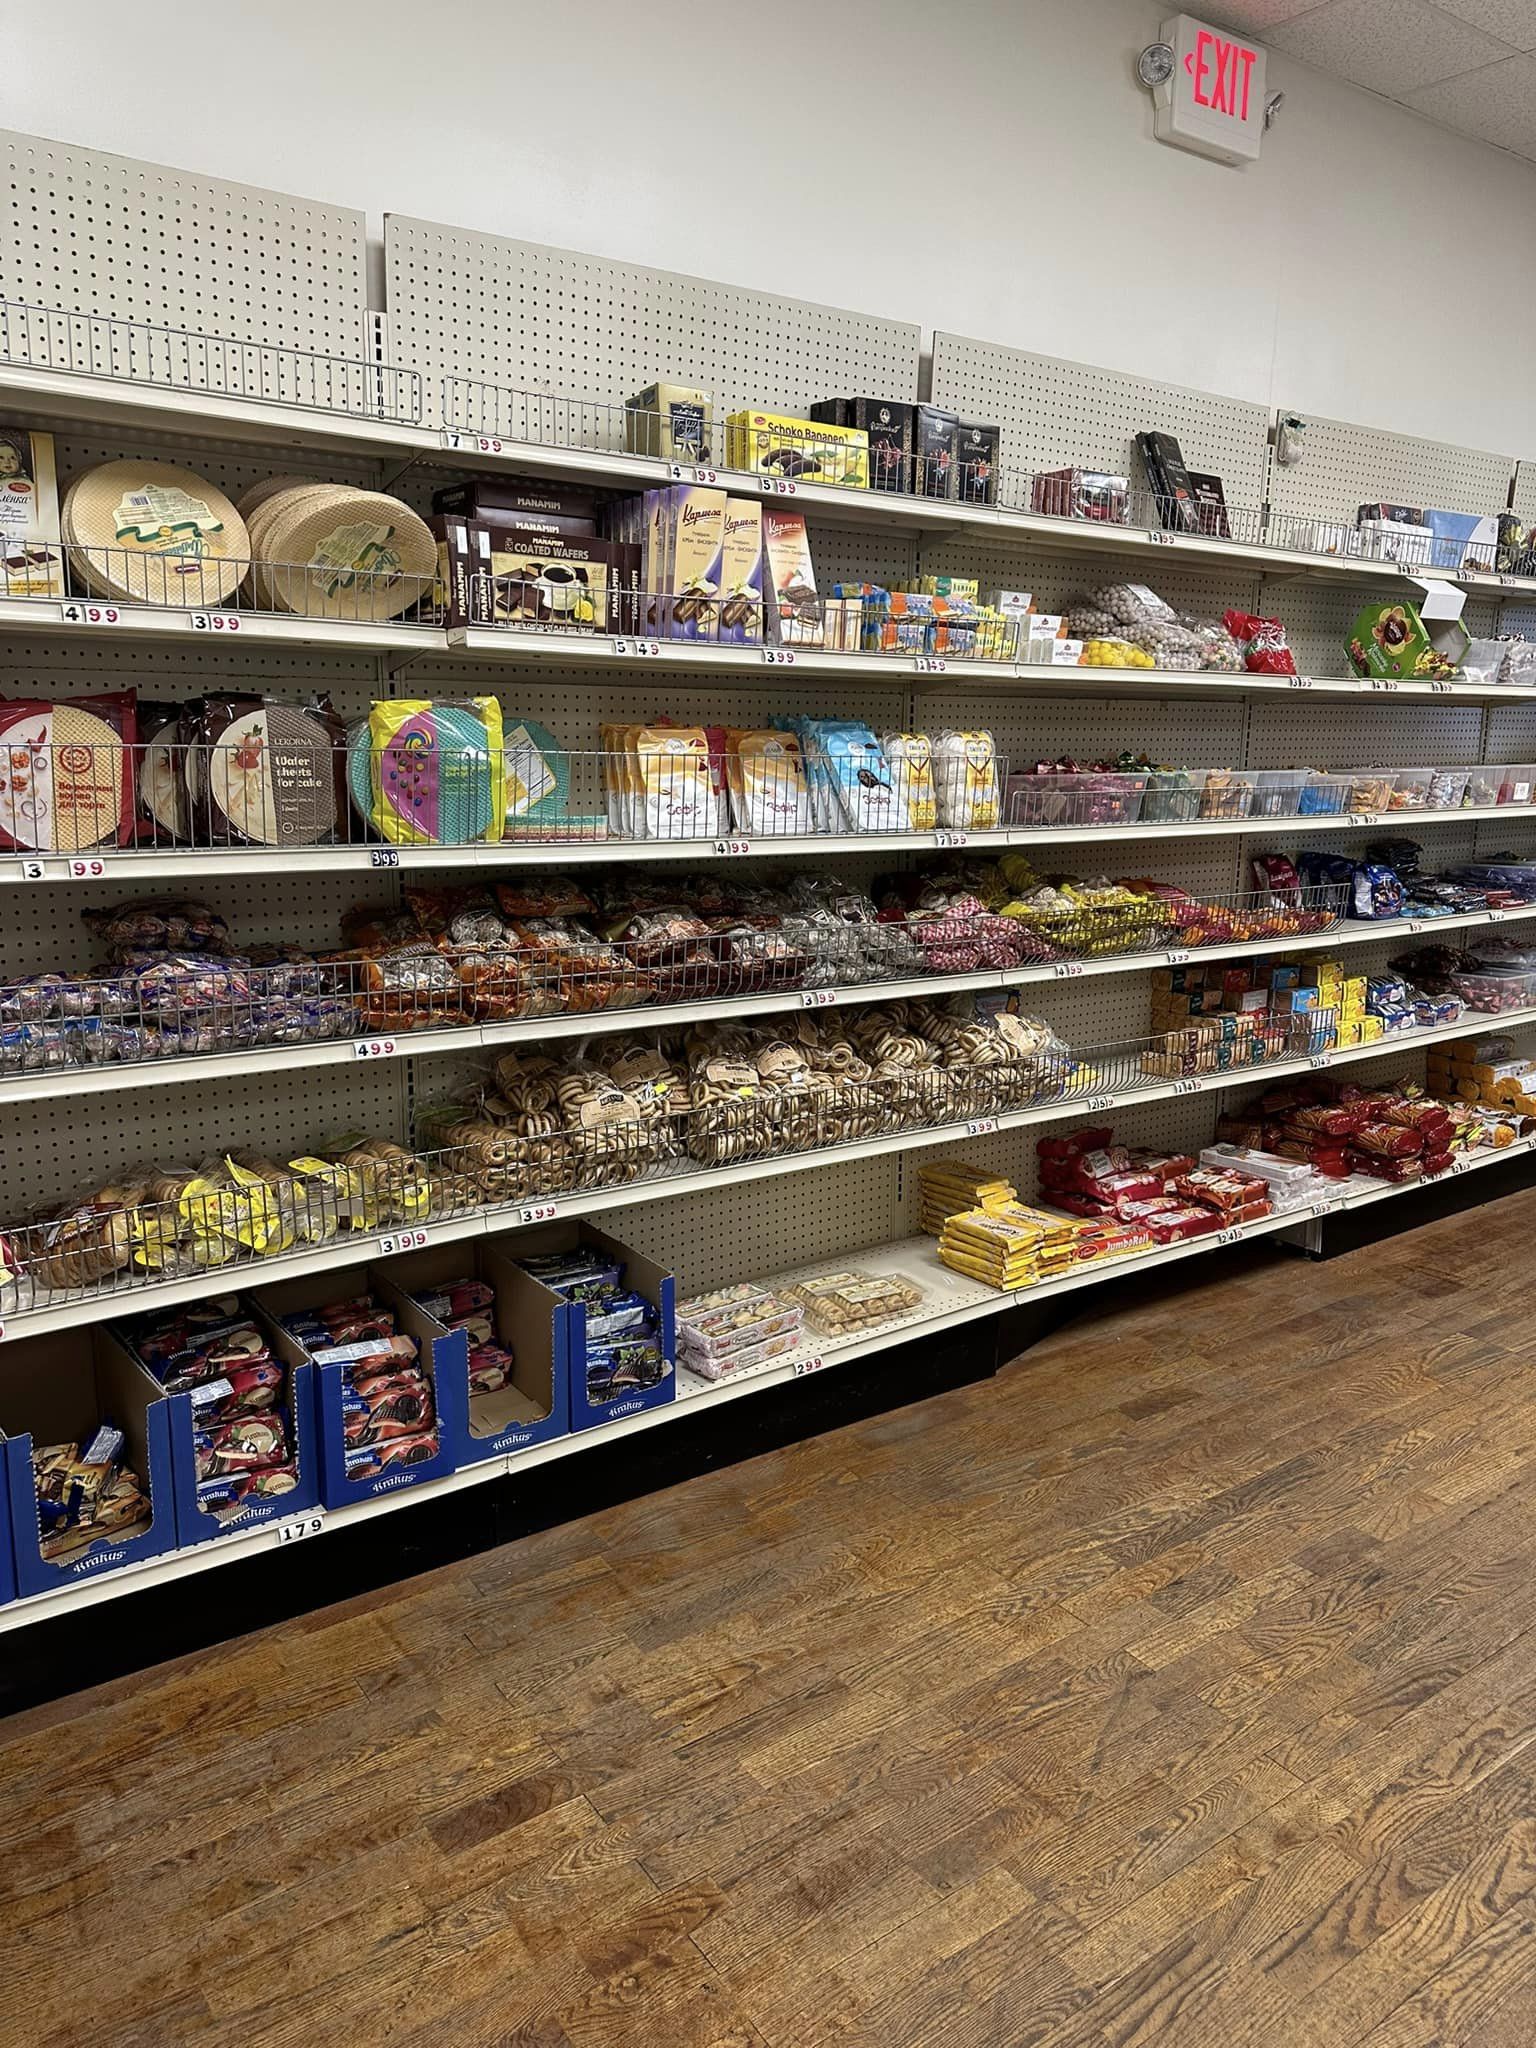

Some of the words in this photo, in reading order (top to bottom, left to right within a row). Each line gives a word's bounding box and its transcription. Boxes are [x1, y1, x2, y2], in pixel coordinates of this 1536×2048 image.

[1193, 29, 1257, 121] EXIT
[767, 421, 802, 439] Schoko
[450, 434, 460, 448] 7
[682, 502, 722, 524] Кармела
[514, 542, 551, 556] COATED
[552, 546, 590, 561] WAFERS
[65, 606, 80, 622] 4
[88, 608, 118, 623] 99
[194, 616, 207, 630] 3
[213, 616, 239, 631] 99
[28, 863, 43, 879] 3
[73, 861, 104, 877] 99
[608, 1401, 645, 1417] Krakus
[492, 1432, 532, 1451] Krakus
[372, 1474, 416, 1493] Krakus
[73, 1551, 126, 1574] Krakus
